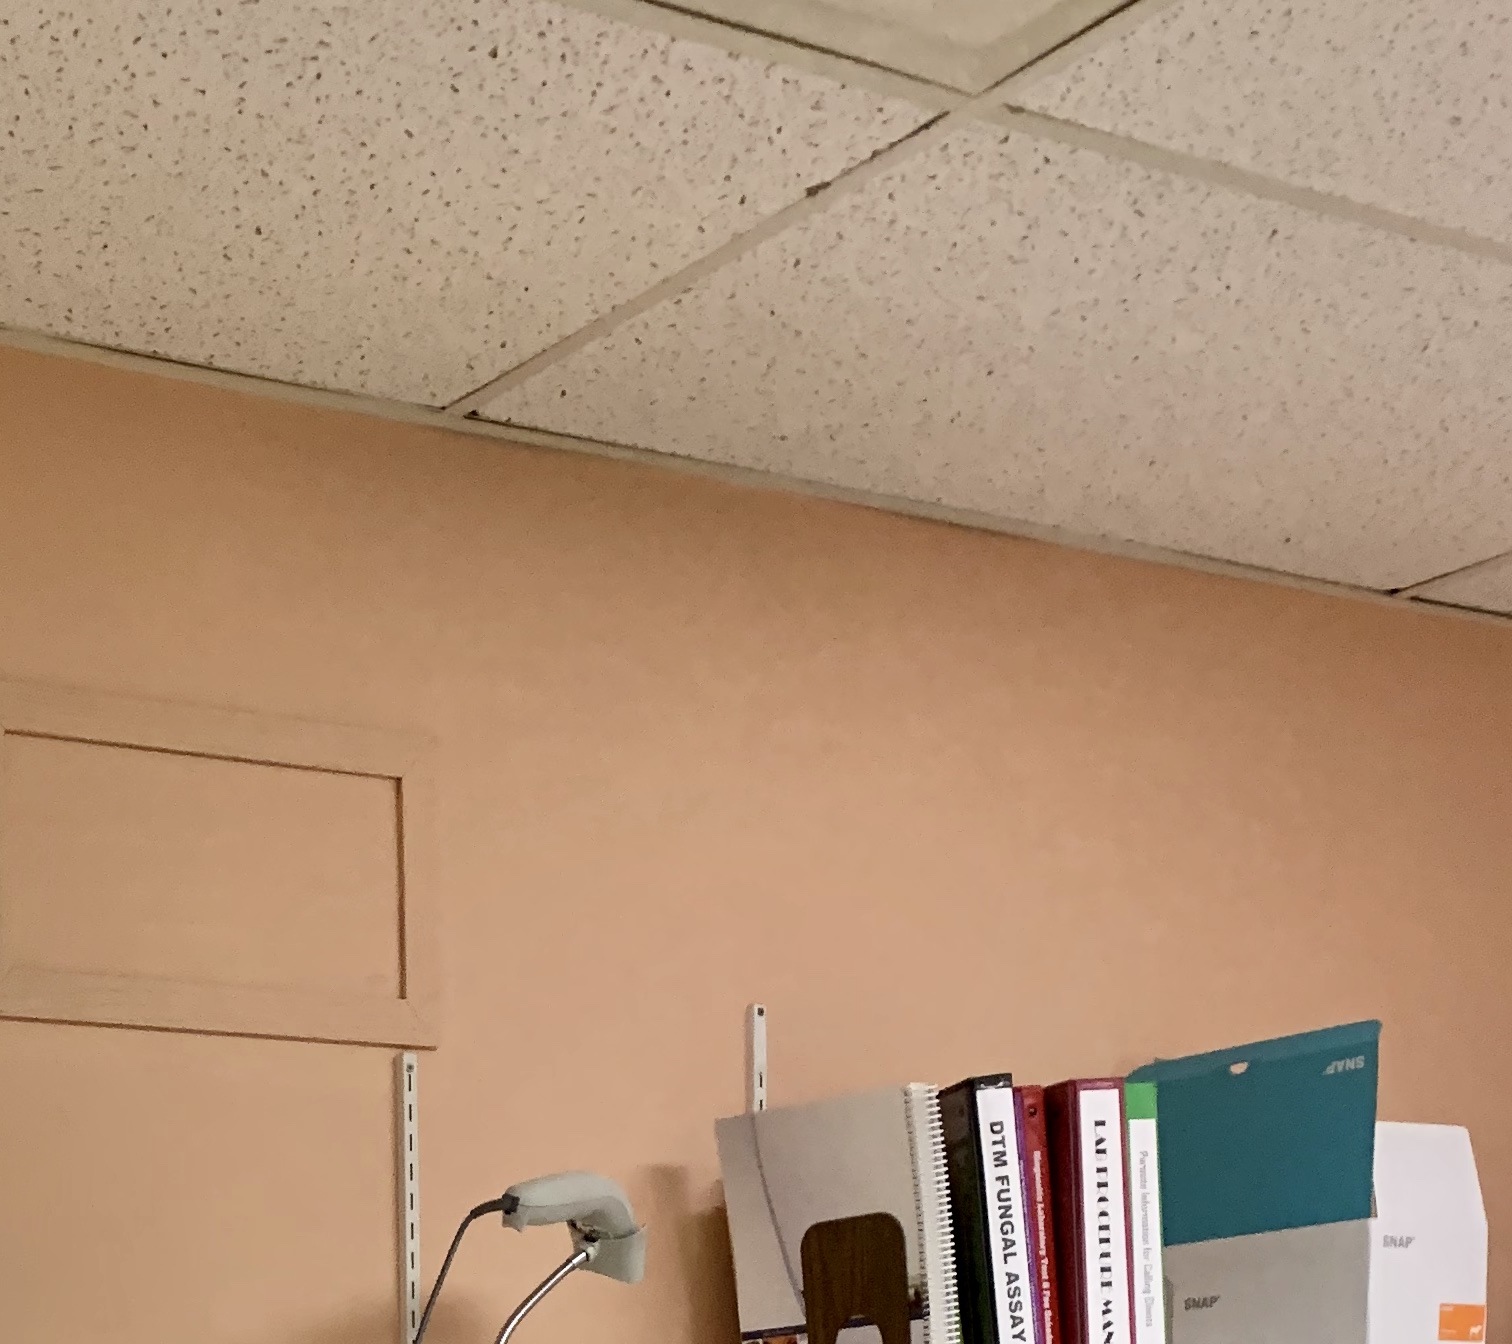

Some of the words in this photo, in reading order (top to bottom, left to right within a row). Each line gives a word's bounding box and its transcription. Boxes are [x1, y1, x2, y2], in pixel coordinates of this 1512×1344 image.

[989, 1120, 1009, 1168] DTM
[995, 1174, 1017, 1265] FUNGAL
[1005, 1271, 1027, 1343] ASSAY
